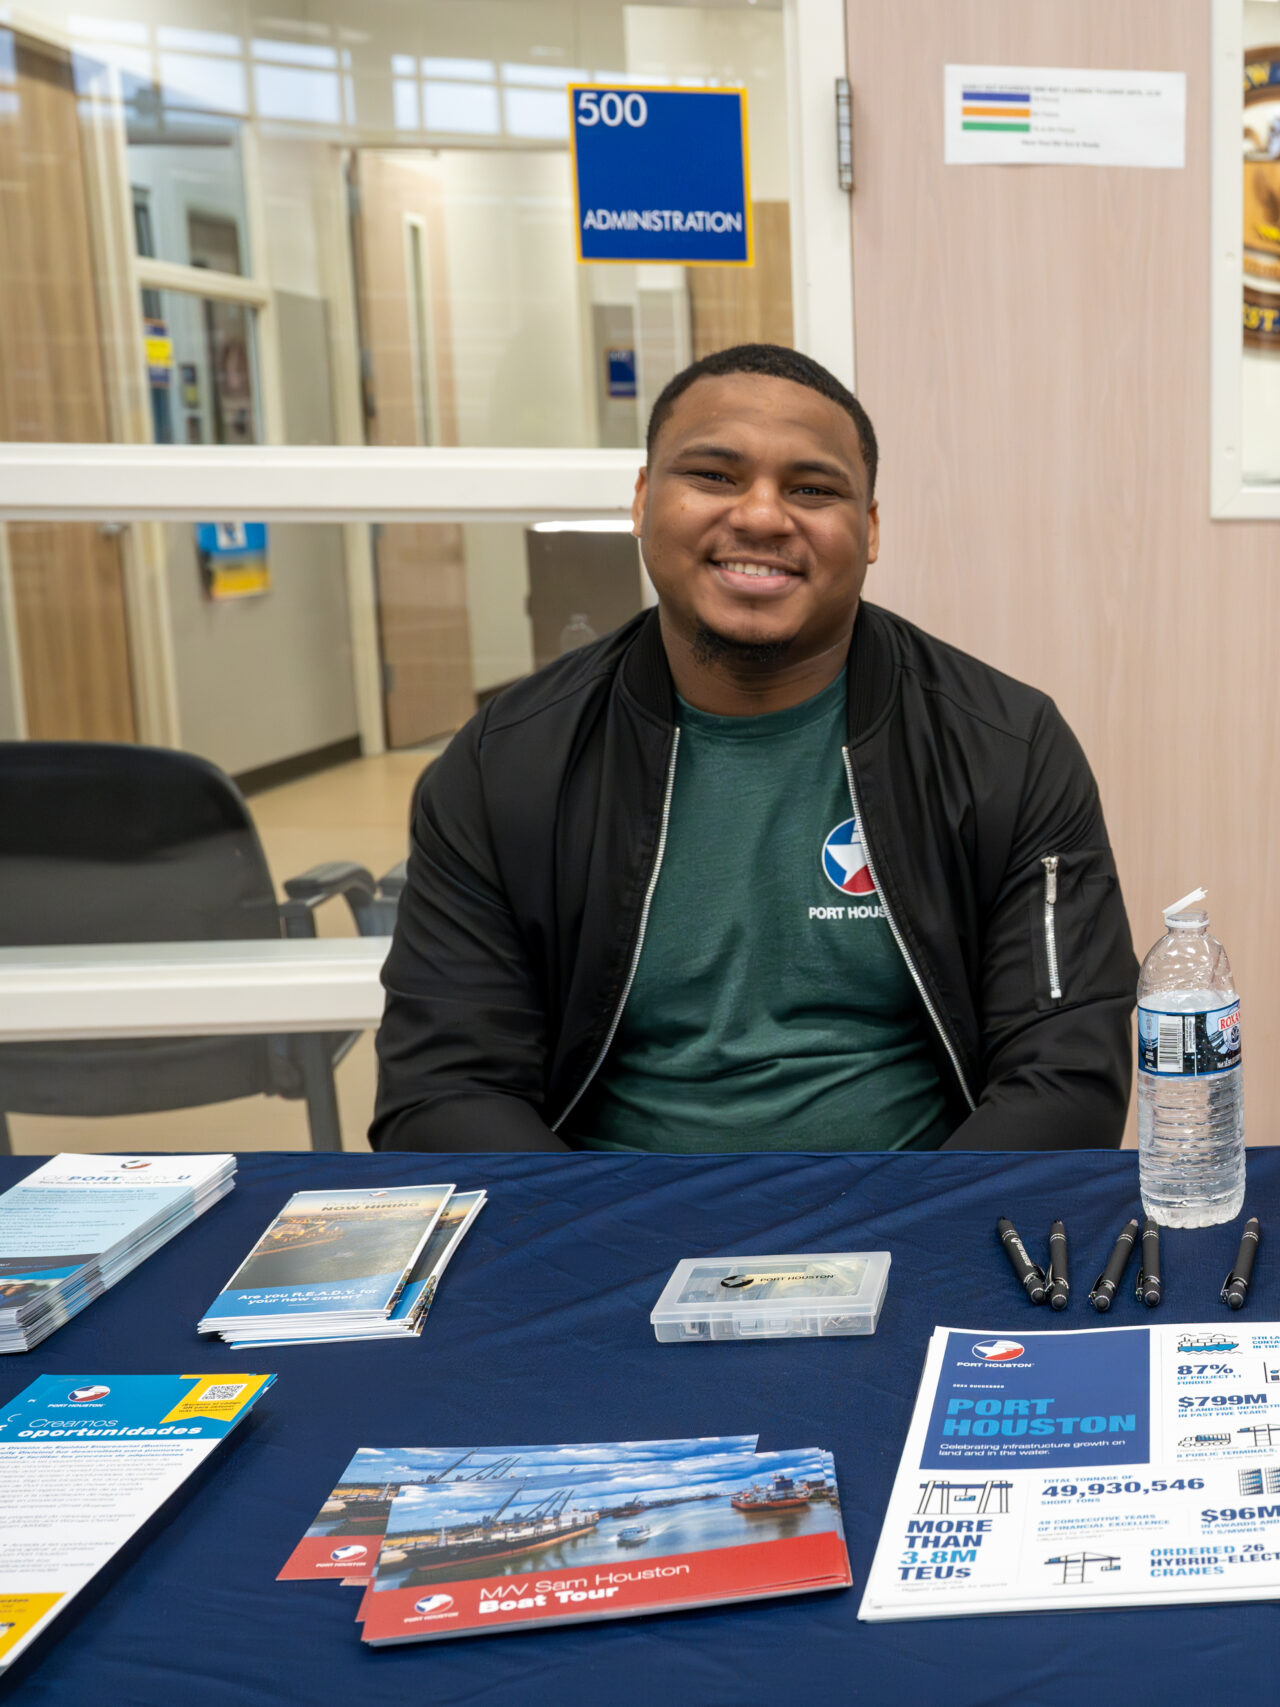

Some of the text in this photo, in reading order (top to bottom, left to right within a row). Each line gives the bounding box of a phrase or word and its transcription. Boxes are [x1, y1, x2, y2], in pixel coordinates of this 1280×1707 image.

[577, 92, 648, 127] 500
[583, 209, 743, 233] ADMINISTRATION
[808, 906, 845, 919] PORT
[322, 1204, 360, 1212] NOW
[364, 1202, 420, 1210] HIRING
[247, 1298, 278, 1306] your
[315, 1293, 363, 1301] career?
[264, 1293, 288, 1301] you
[1177, 1363, 1234, 1375] 87%
[946, 1398, 1055, 1416] PORT
[1178, 1393, 1268, 1408] $799M
[29, 1418, 119, 1428] Creamos
[942, 1414, 1136, 1437] HOUSTON
[18, 1425, 202, 1438] oportunidades
[940, 1442, 1000, 1450] Celebrating
[1002, 1441, 1071, 1449] infrastructure
[1073, 1439, 1109, 1448] growth
[1041, 1478, 1205, 1499] 49,930,546
[907, 1519, 993, 1534] MORE
[1053, 1523, 1103, 1531] FINANCIAL
[1105, 1520, 1171, 1528] EXCELLENCE
[1054, 1516, 1120, 1525] CONSECUTIVE
[1214, 1520, 1256, 1528] AWARDS
[904, 1534, 983, 1549] THAN
[1150, 1543, 1265, 1557] ORDERED 26
[900, 1549, 978, 1565] 3.8M
[897, 1566, 972, 1581] TEUs
[1150, 1565, 1225, 1577] CRANES
[534, 1577, 587, 1592] Sam
[594, 1564, 690, 1586] Houston
[478, 1585, 620, 1614] Boat Tour
[403, 1611, 460, 1624] PORT HOUSTON
